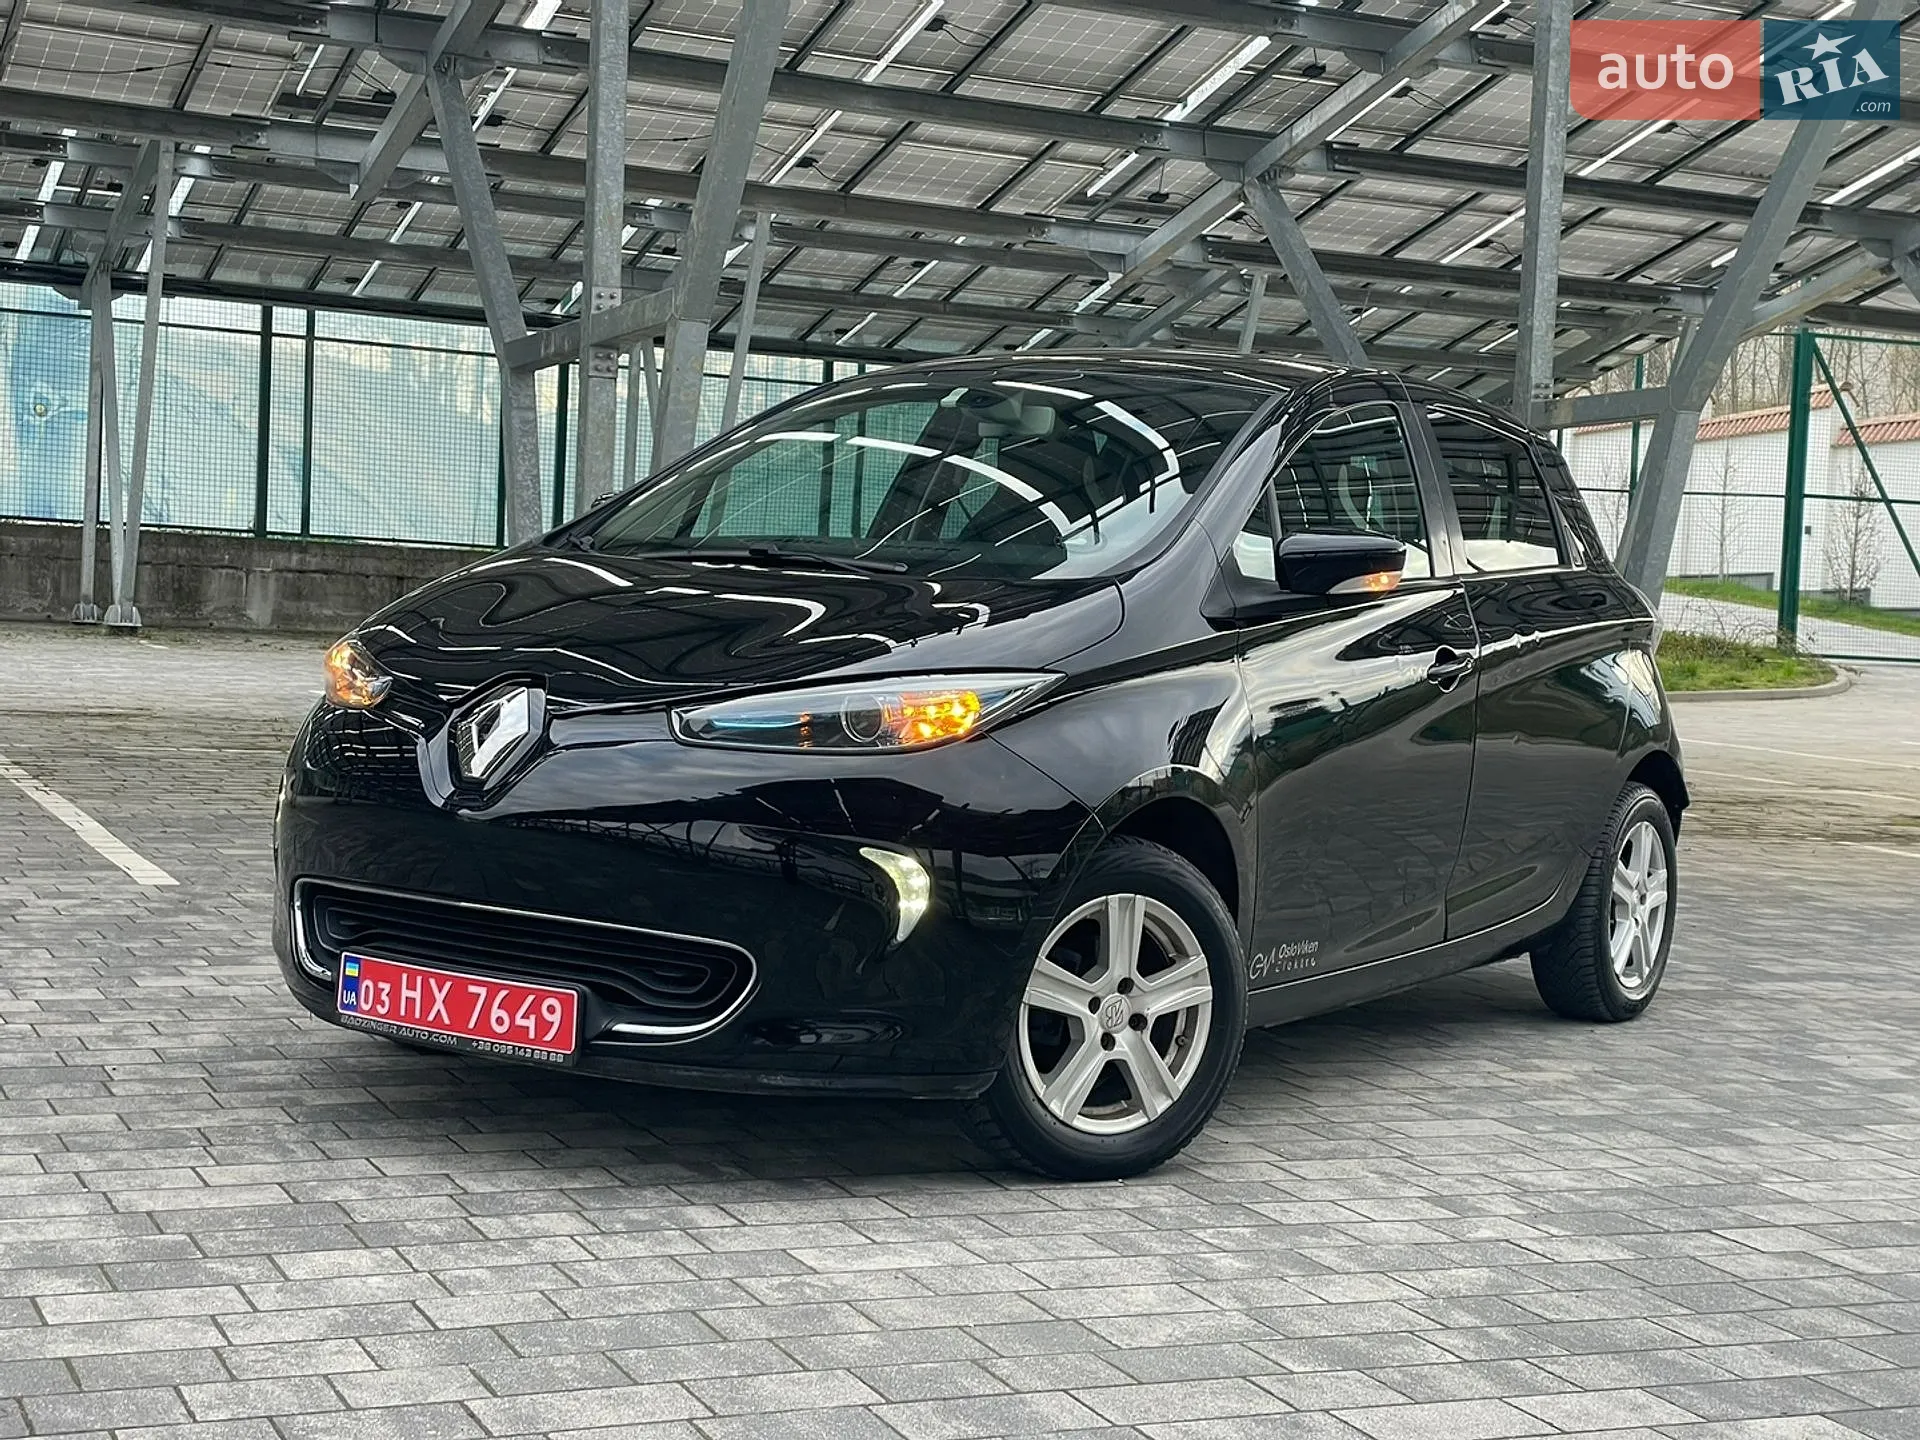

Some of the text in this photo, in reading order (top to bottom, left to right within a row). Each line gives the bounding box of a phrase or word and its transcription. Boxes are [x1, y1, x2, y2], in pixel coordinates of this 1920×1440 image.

[343, 989, 358, 1006] UA
[360, 972, 564, 1042] 03 HX 7649
